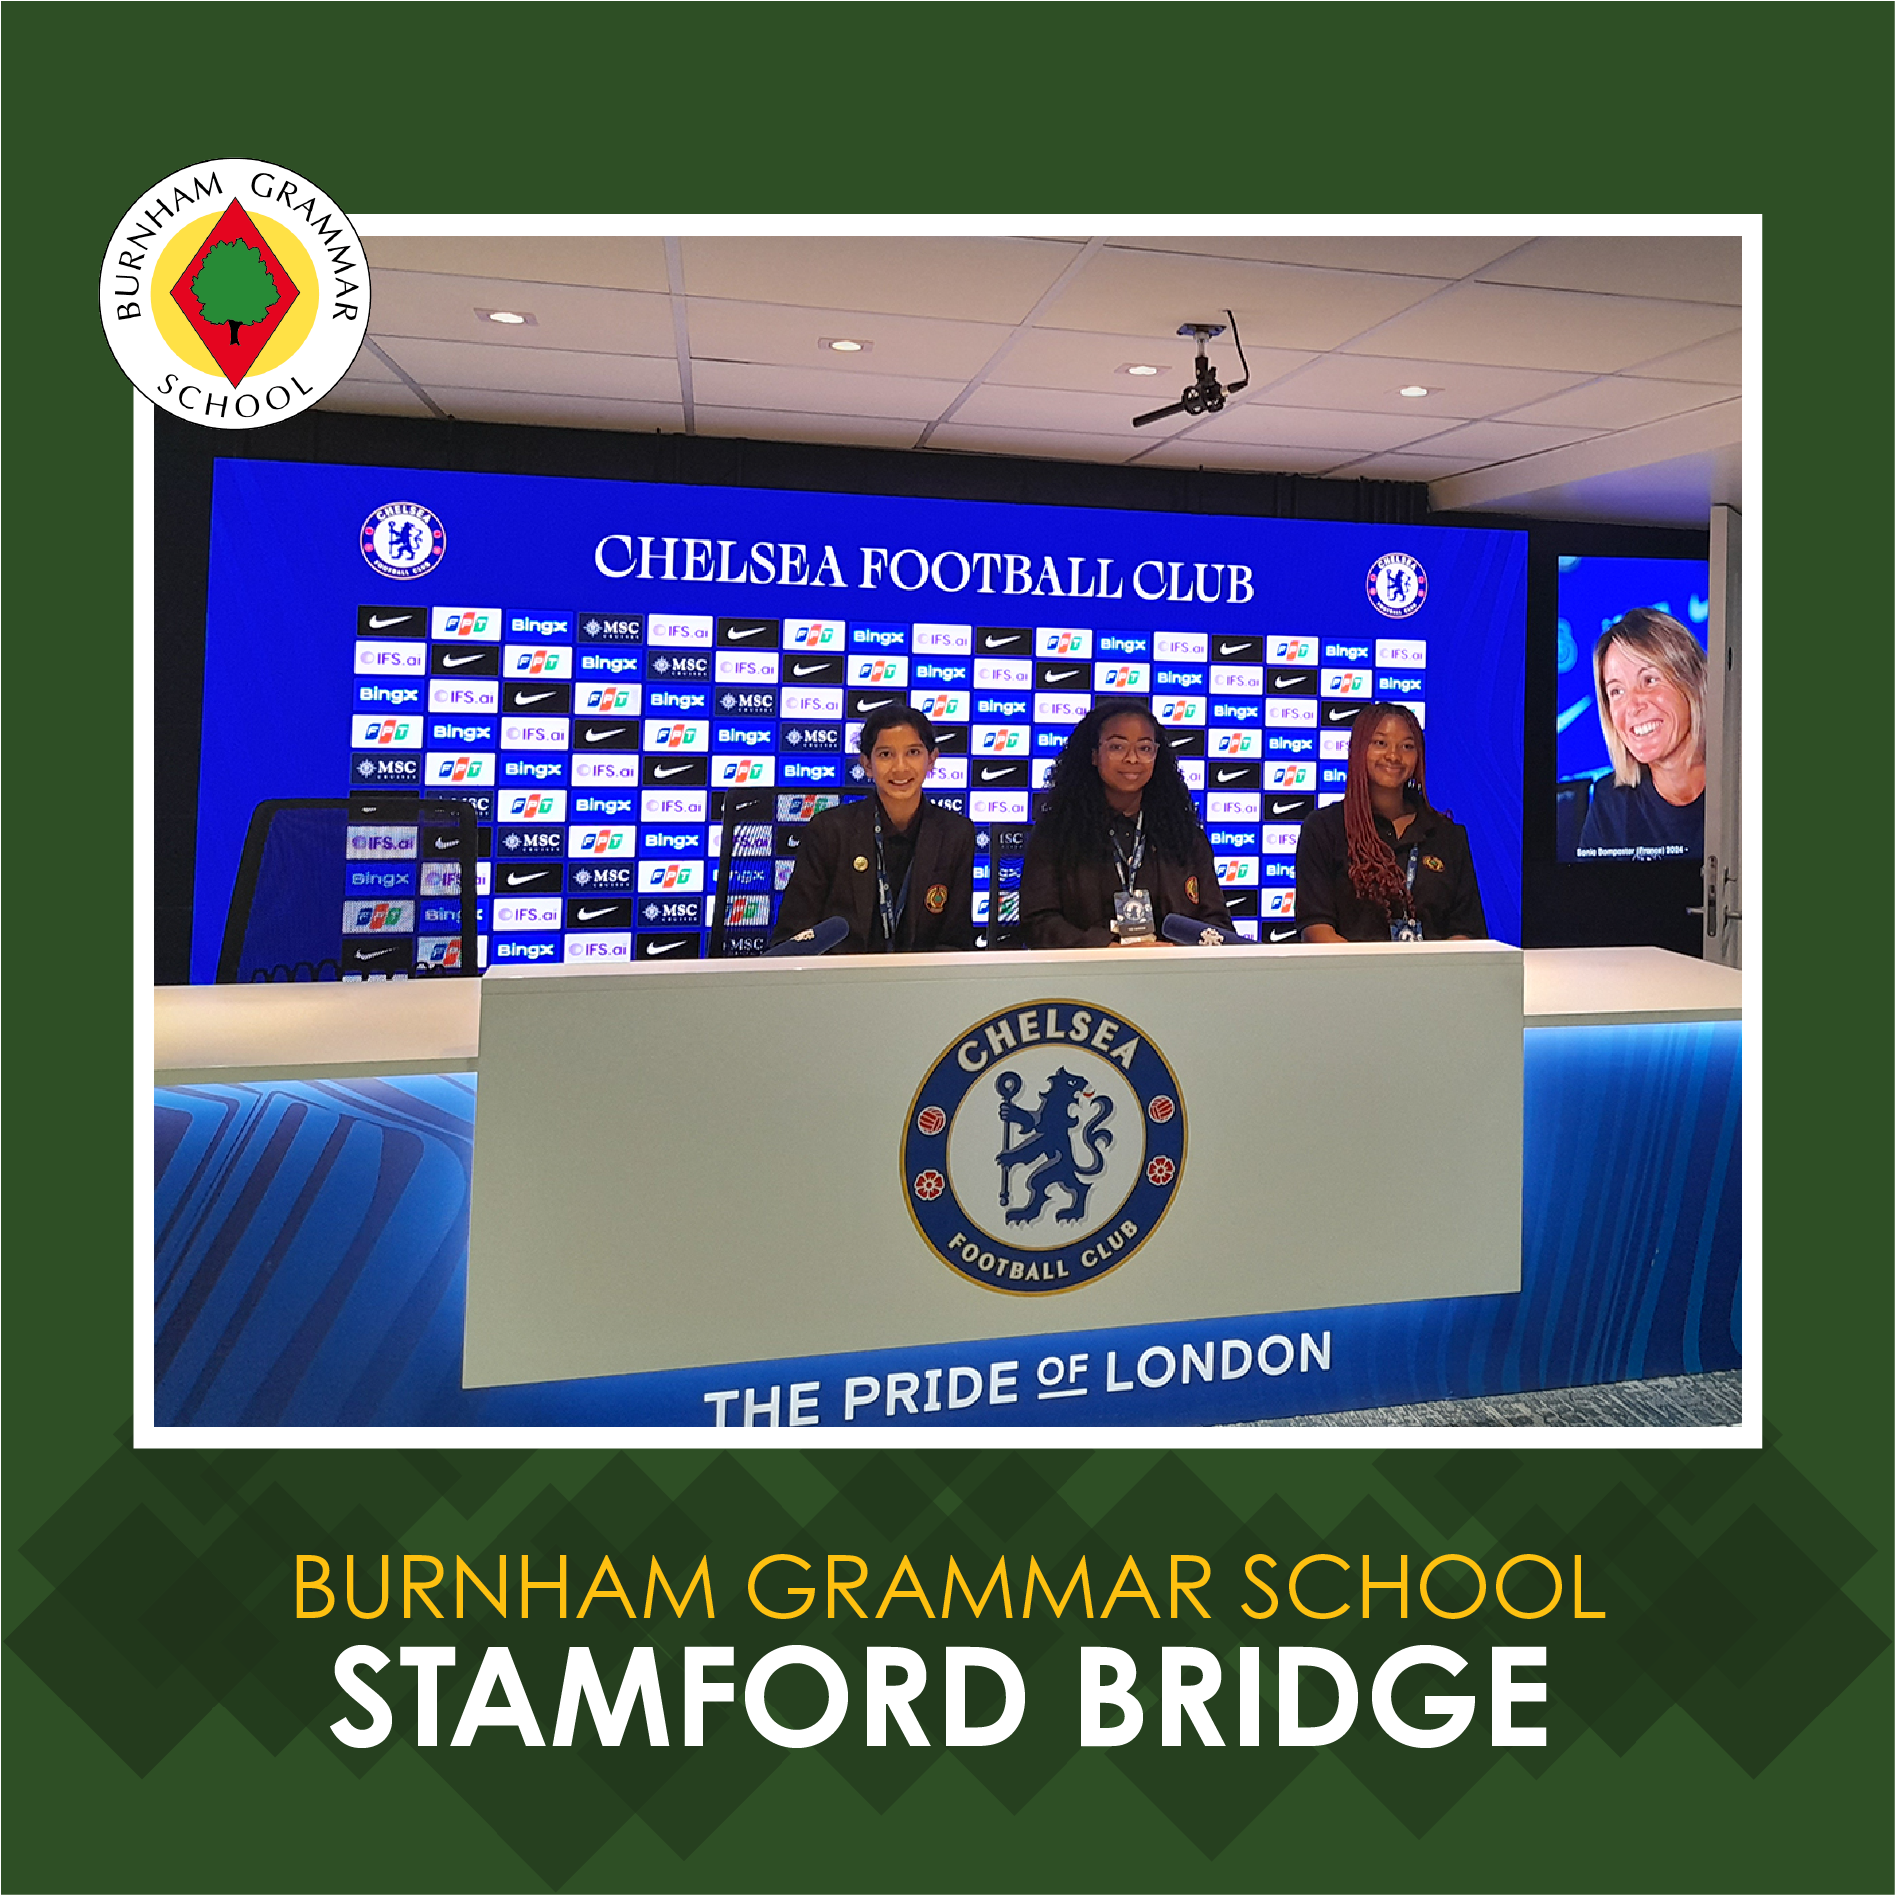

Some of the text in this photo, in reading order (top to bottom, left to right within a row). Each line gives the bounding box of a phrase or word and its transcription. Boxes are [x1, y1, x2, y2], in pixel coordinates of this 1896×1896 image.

[595, 535, 1254, 604] CHELSEA FOOTBALL CLUB
[445, 612, 489, 635] FPT
[604, 622, 639, 633] MSC
[669, 626, 708, 638] IFS.ai
[795, 624, 834, 646] FPT
[931, 634, 967, 646] IFS.ai
[1047, 632, 1082, 653] FPT
[1170, 643, 1204, 653] IFS.ai
[1277, 640, 1309, 660] FPT
[1391, 649, 1422, 660] IFS.ai
[378, 653, 420, 665] IFS.ai
[517, 651, 559, 673] FPT
[672, 658, 707, 671] MSC
[735, 662, 774, 674] IFS.ai
[859, 661, 896, 681] FPT
[993, 669, 1027, 680] IFS.ai
[1105, 666, 1139, 687] FPT
[1227, 676, 1259, 686] IFS.ai
[1330, 673, 1363, 692] FPT
[451, 691, 493, 703] IFS.ai
[587, 687, 629, 711] FPT
[739, 695, 772, 706] MSC
[801, 699, 838, 710] IFS.ai
[922, 695, 959, 716] FPT
[1162, 701, 1196, 721] FPT
[1282, 709, 1313, 719] IFS.ai
[365, 720, 409, 744] FPT
[522, 728, 564, 740] IFS.ai
[657, 724, 697, 747] FPT
[804, 729, 837, 742] MSC
[984, 729, 1019, 751] FPT
[1039, 733, 1067, 745] Bin
[1219, 733, 1251, 752] FPT
[378, 761, 416, 773] MSC
[439, 757, 482, 781] FPT
[593, 765, 634, 777] IFS.ai
[724, 760, 763, 783] FPT
[1274, 765, 1306, 786] FPT
[1324, 768, 1346, 781] Bin
[510, 794, 553, 817] FPT
[661, 800, 701, 813] IFS.ai
[988, 802, 1024, 812] IFS.ai
[1223, 802, 1257, 812] IFS.ai
[524, 833, 560, 846] MSC
[581, 830, 623, 853] FPT
[1278, 834, 1296, 844] IFS
[594, 869, 630, 881] MSC
[650, 865, 692, 888] FPT
[1266, 864, 1295, 878] Bing
[1271, 892, 1295, 912] FP
[515, 909, 557, 921] IFS.ai
[662, 904, 697, 916] MSC
[431, 939, 462, 965] FP
[586, 944, 626, 955] IFS.ai
[958, 1009, 1140, 1071] CHELSEA
[948, 1220, 1137, 1281] FOOTBALL CLUB
[704, 1331, 1330, 1426] THE PRIDE OF LONDON
